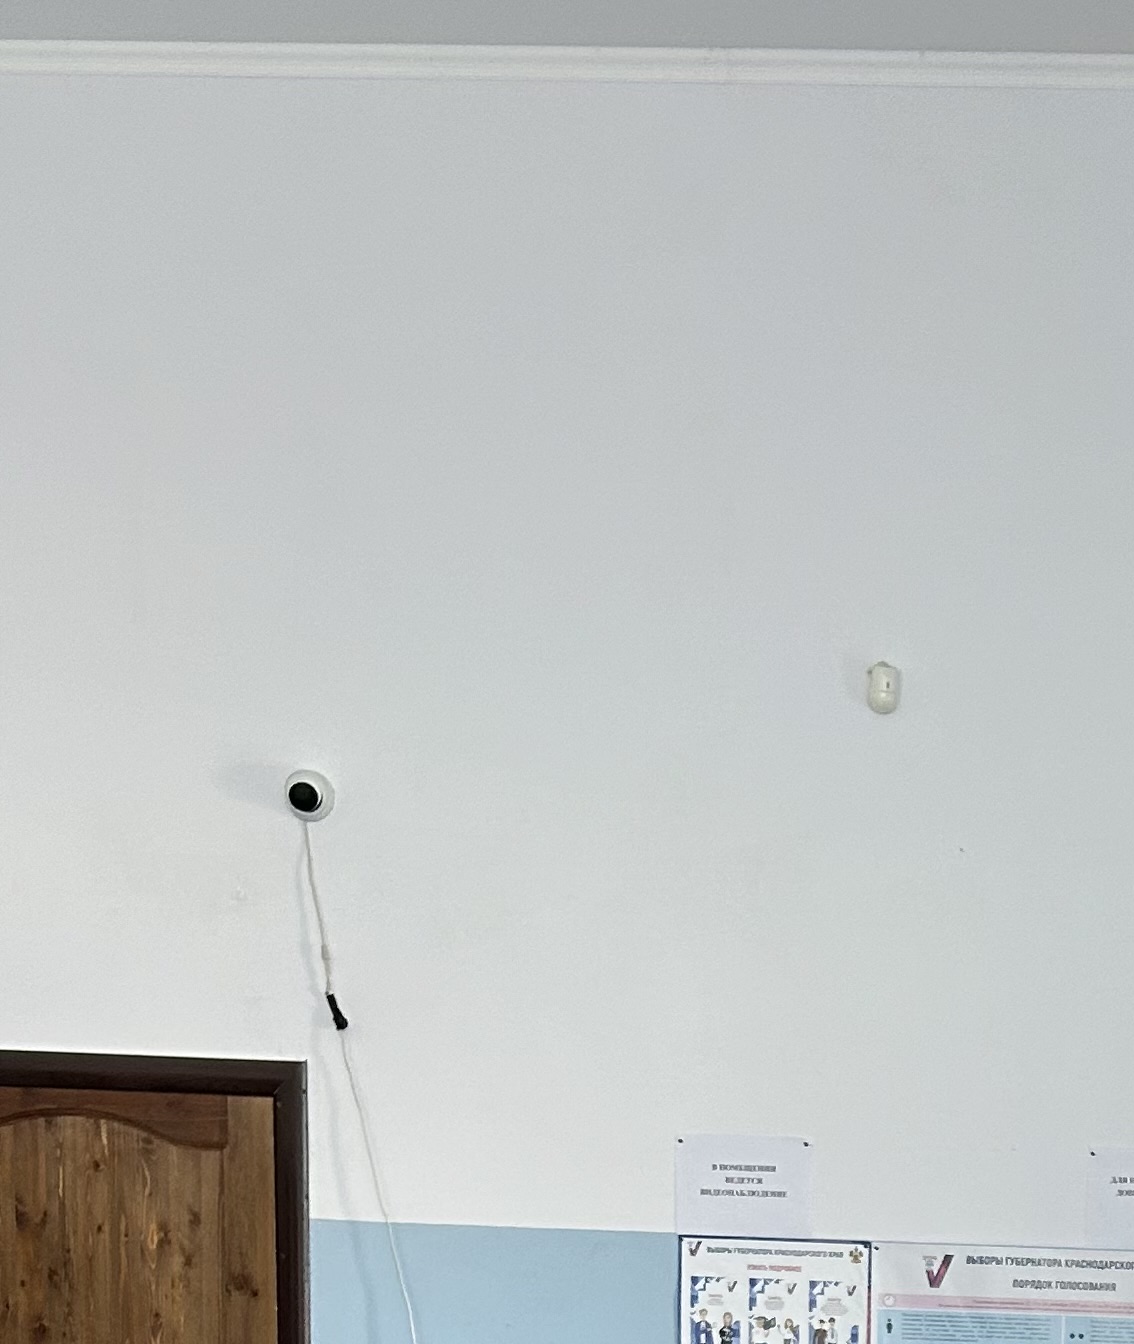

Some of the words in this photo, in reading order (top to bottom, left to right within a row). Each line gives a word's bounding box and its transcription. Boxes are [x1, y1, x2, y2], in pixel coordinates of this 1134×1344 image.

[1110, 1176, 1128, 1184] ДЛЯ
[966, 1255, 1004, 1265] ВЫБОРЫ
[1005, 1257, 1063, 1268] ГУБЕРНАТОРА
[1012, 1279, 1053, 1290] ПОРЯДОК
[1055, 1280, 1117, 1292] ГОЛОСОВАНИЯ
